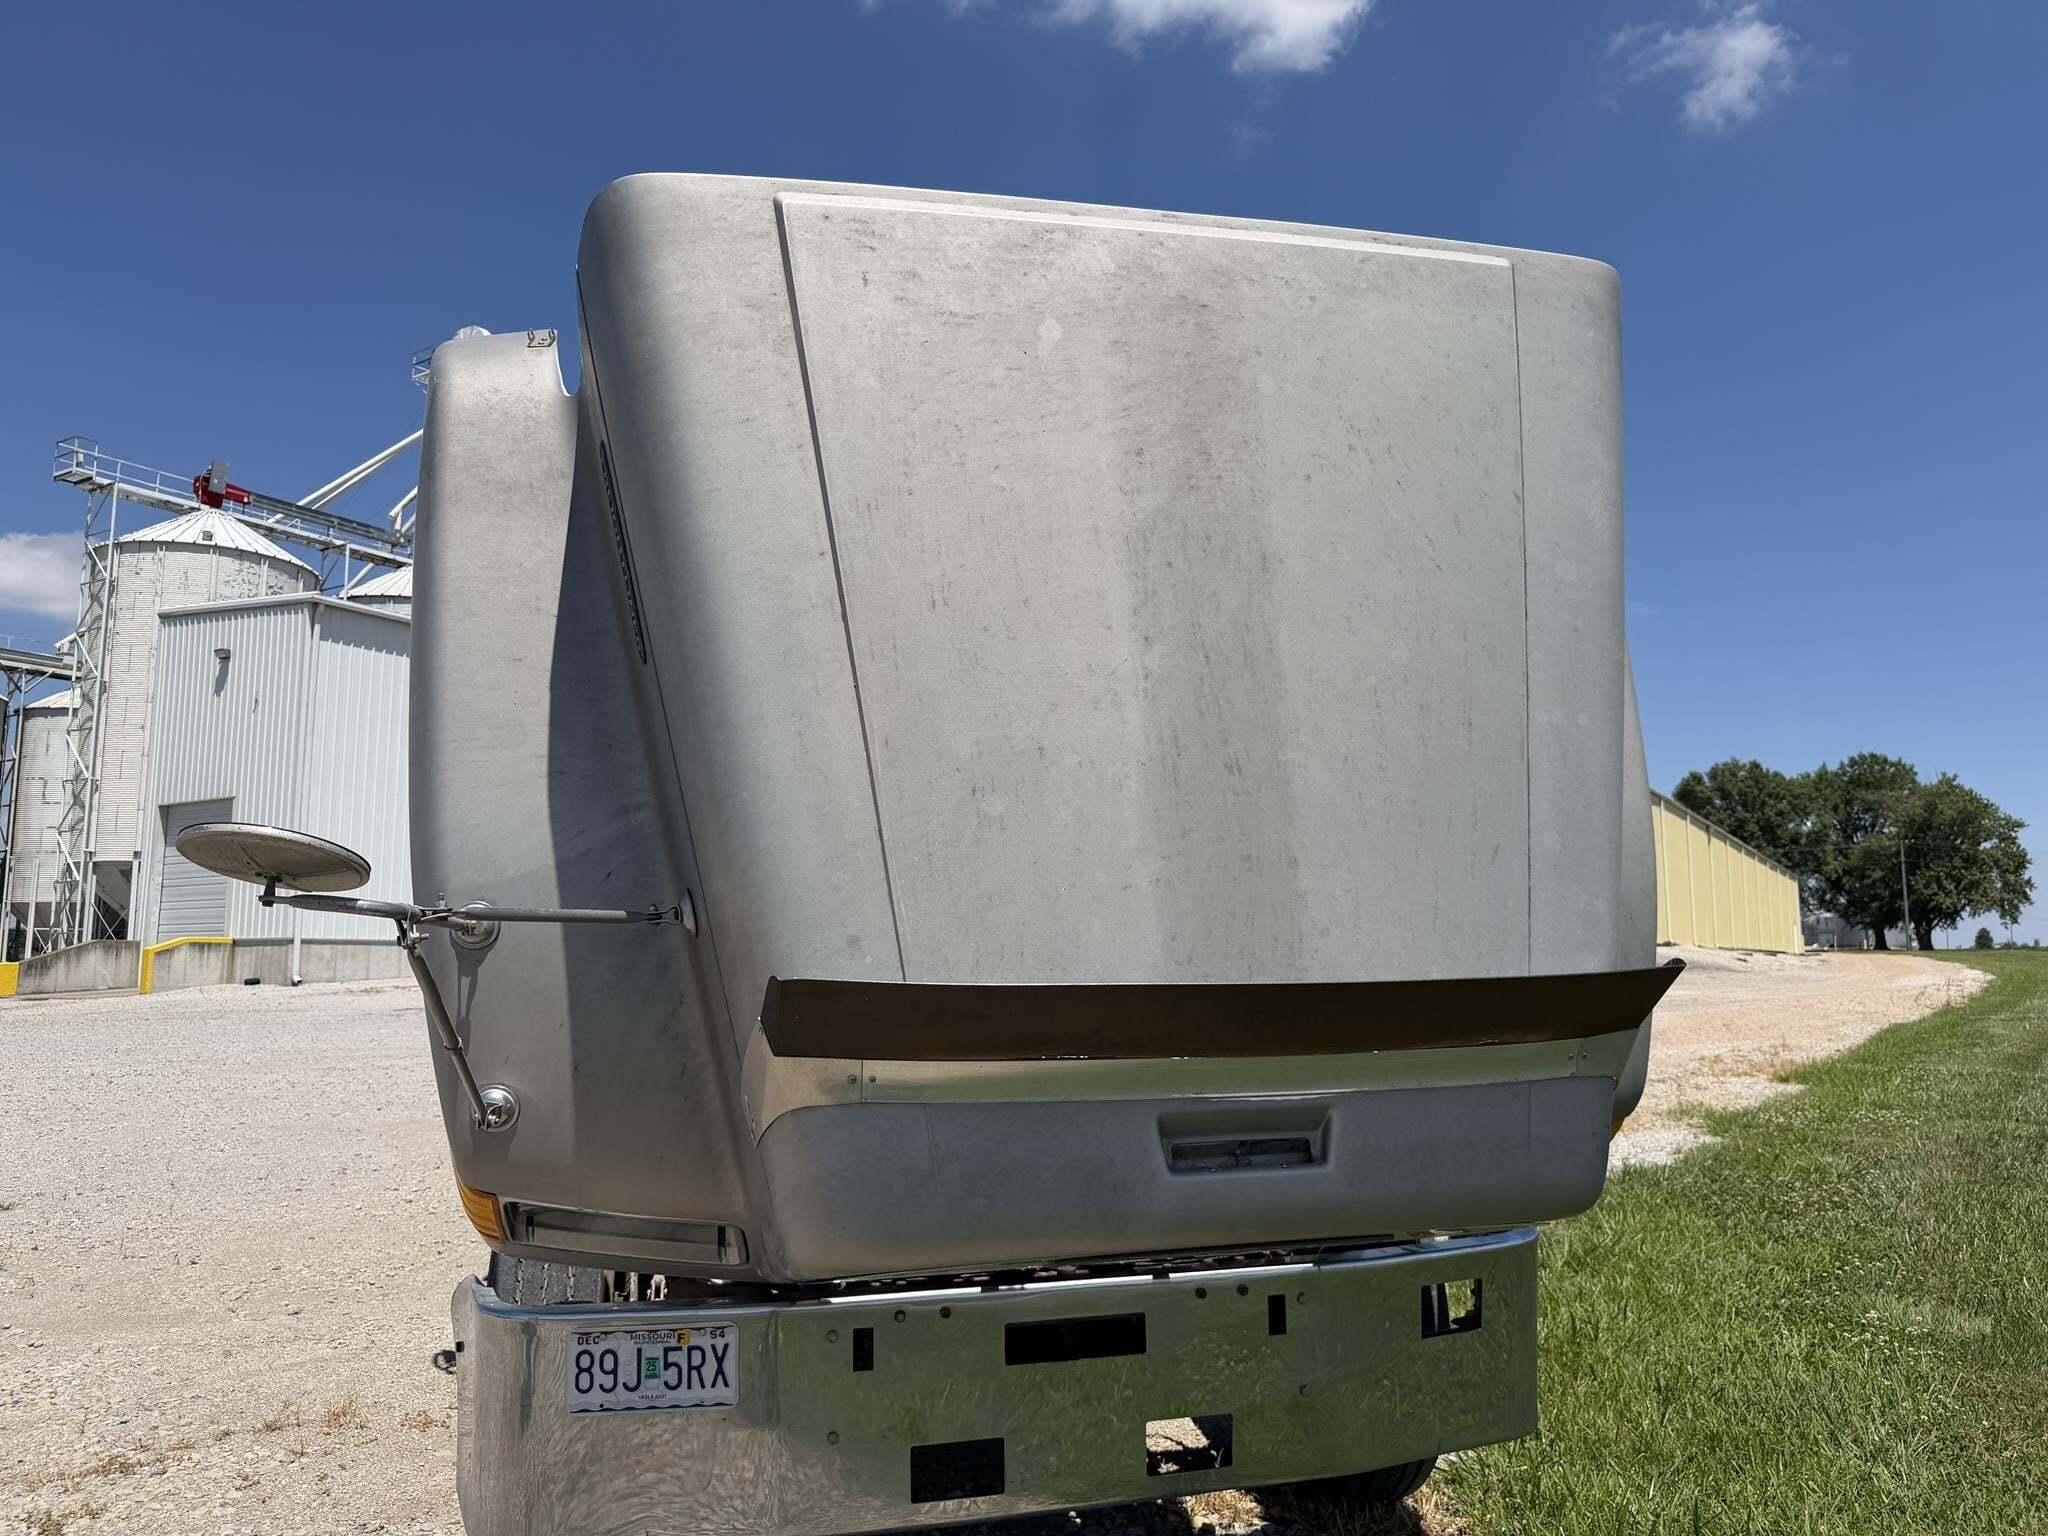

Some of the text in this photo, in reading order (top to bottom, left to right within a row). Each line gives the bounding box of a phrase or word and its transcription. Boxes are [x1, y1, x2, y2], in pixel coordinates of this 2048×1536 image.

[577, 1335, 600, 1345] DEC
[630, 1332, 676, 1341] MISSOURI
[677, 1333, 686, 1344] F
[575, 1343, 729, 1394] 89J 5RX
[646, 1360, 657, 1372] 25
